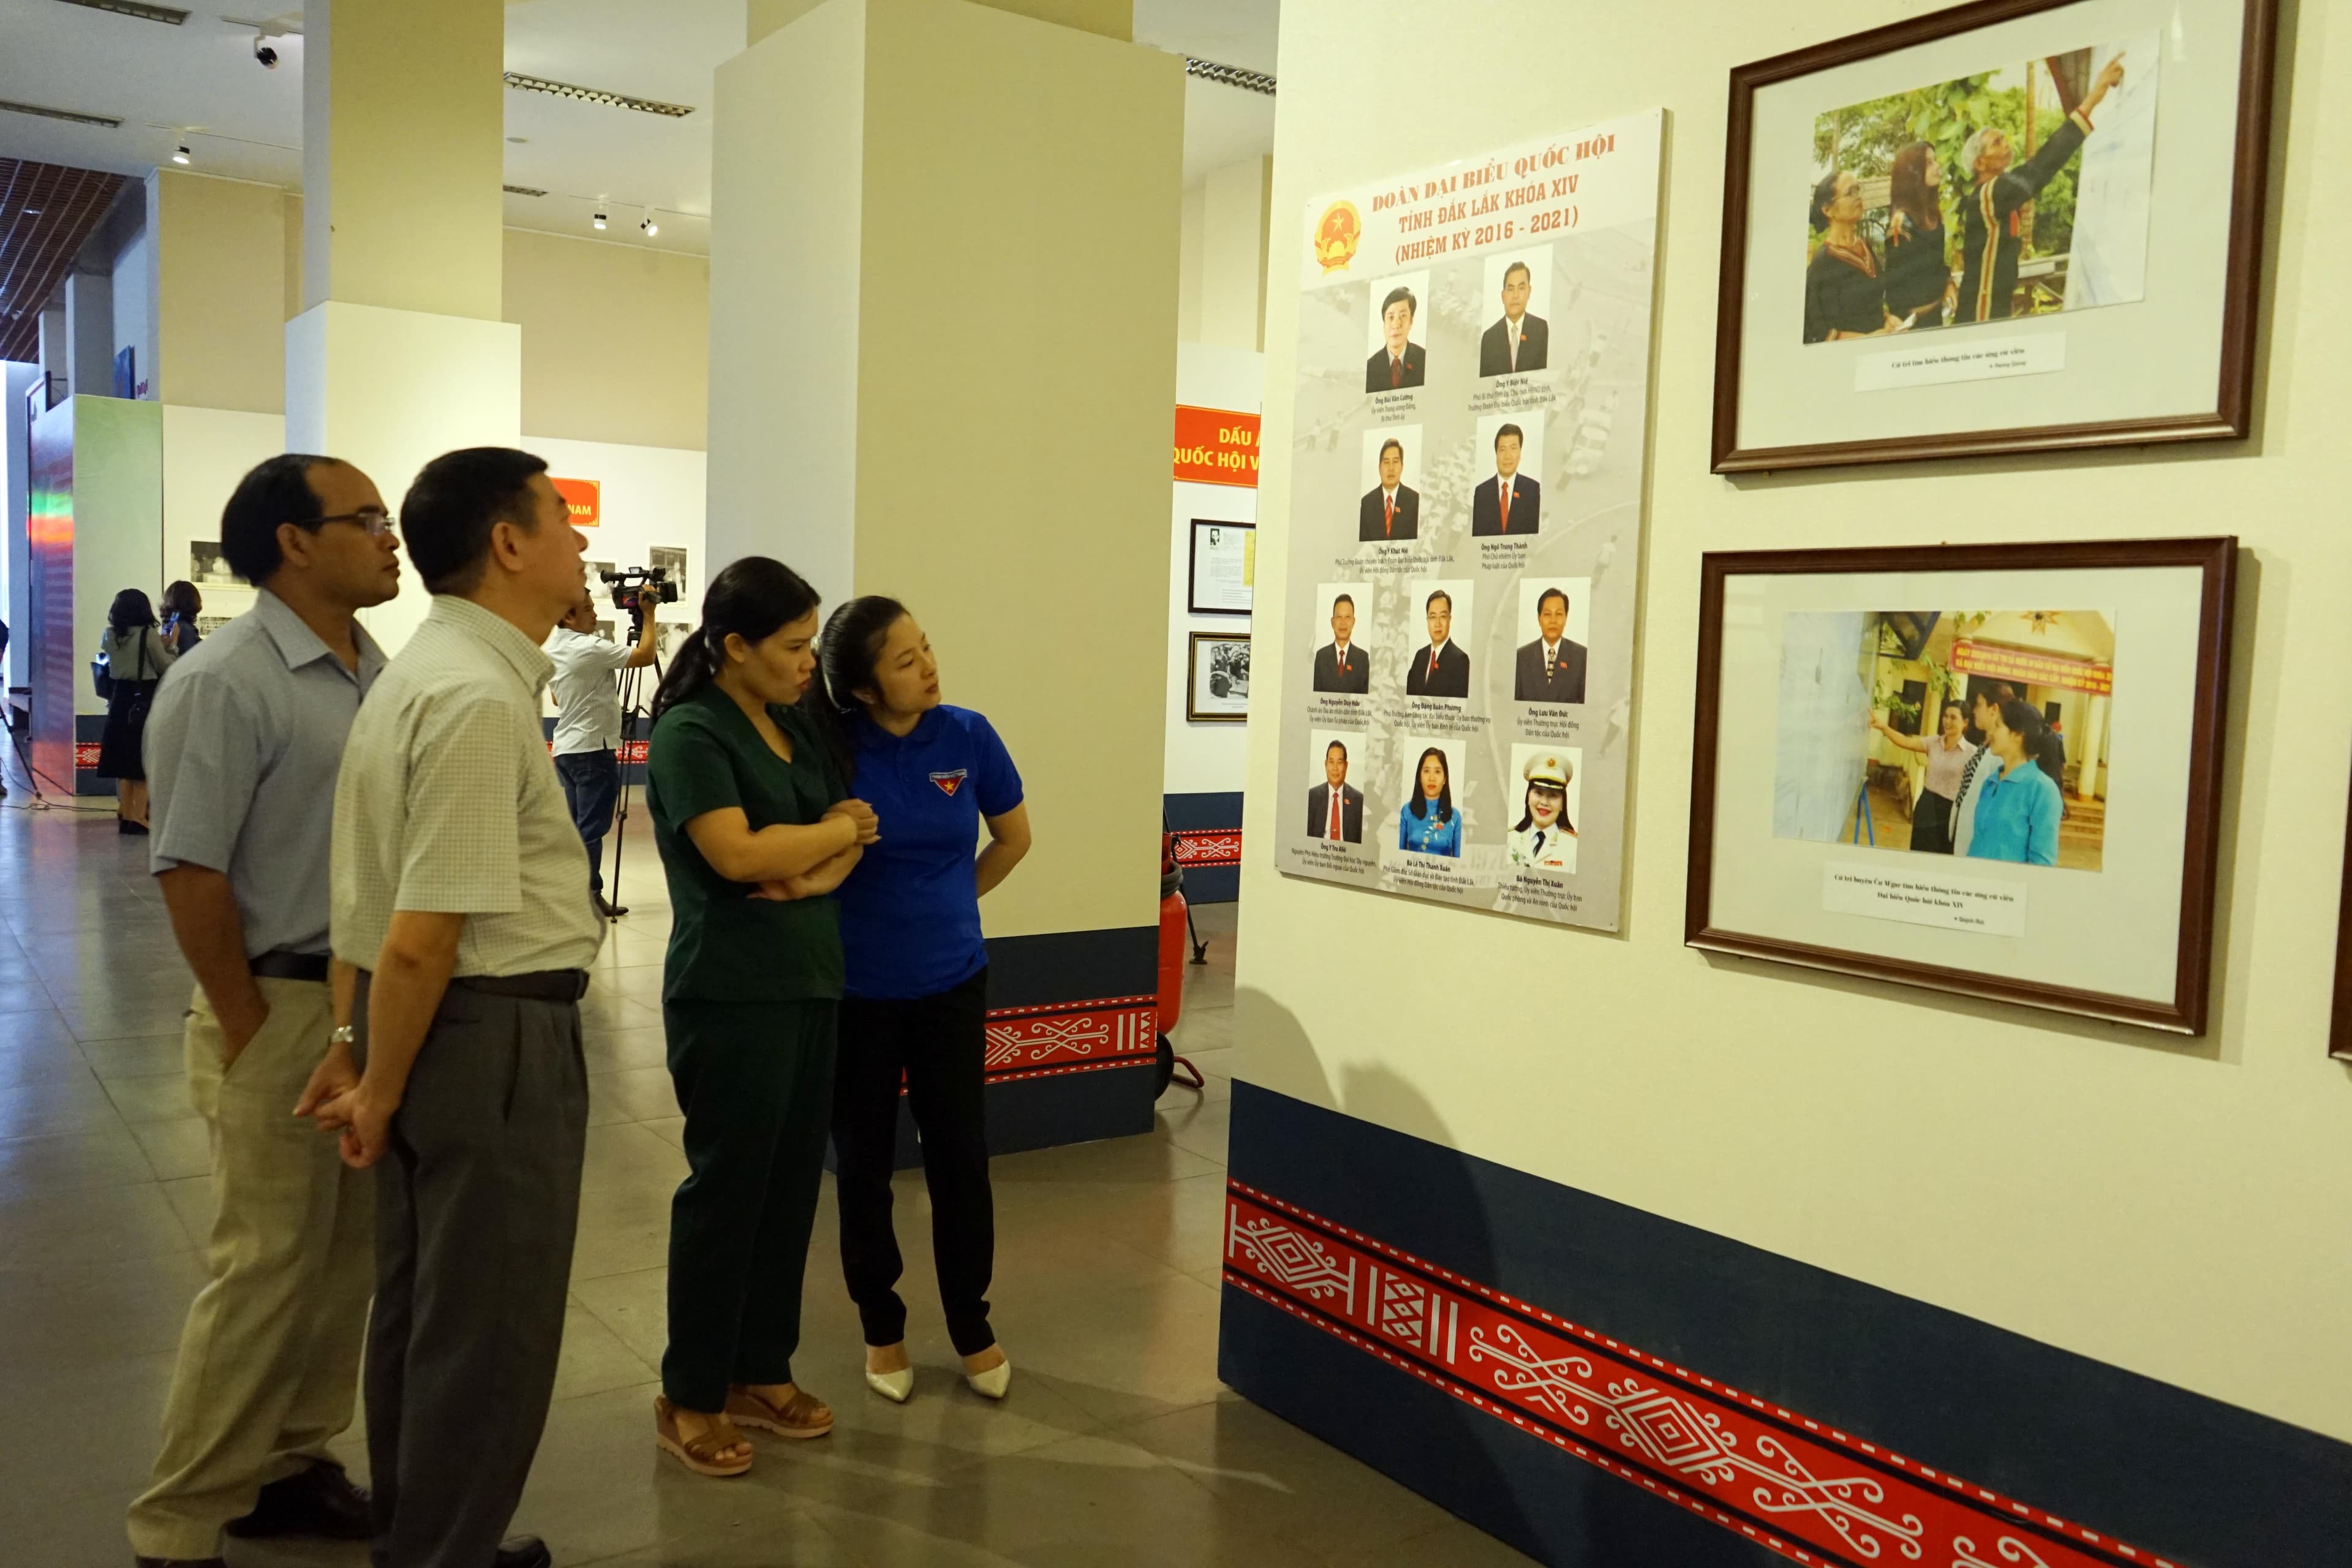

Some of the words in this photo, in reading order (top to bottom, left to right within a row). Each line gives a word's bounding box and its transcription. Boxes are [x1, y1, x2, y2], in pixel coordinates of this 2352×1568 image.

[1463, 157, 1508, 189] BIỂU
[1515, 143, 1569, 179] QUỐC
[1575, 134, 1616, 160] HỘI
[1399, 210, 1433, 233] TỈNH
[1438, 198, 1466, 225] ĐẮK
[1471, 190, 1499, 216] LẮK
[1505, 181, 1546, 209] KHÓA
[1551, 174, 1578, 198] XIV
[1396, 235, 1447, 265] (NHIỆM
[1452, 228, 1471, 251] KỲ
[1475, 221, 1513, 246] 2016
[1531, 205, 1578, 233] 2021)
[1219, 426, 1251, 446] DẤU
[1174, 446, 1214, 466] QUỐC
[1218, 451, 1246, 472] HỘI
[568, 504, 591, 516] NAM
[1529, 707, 1538, 717] Ông
